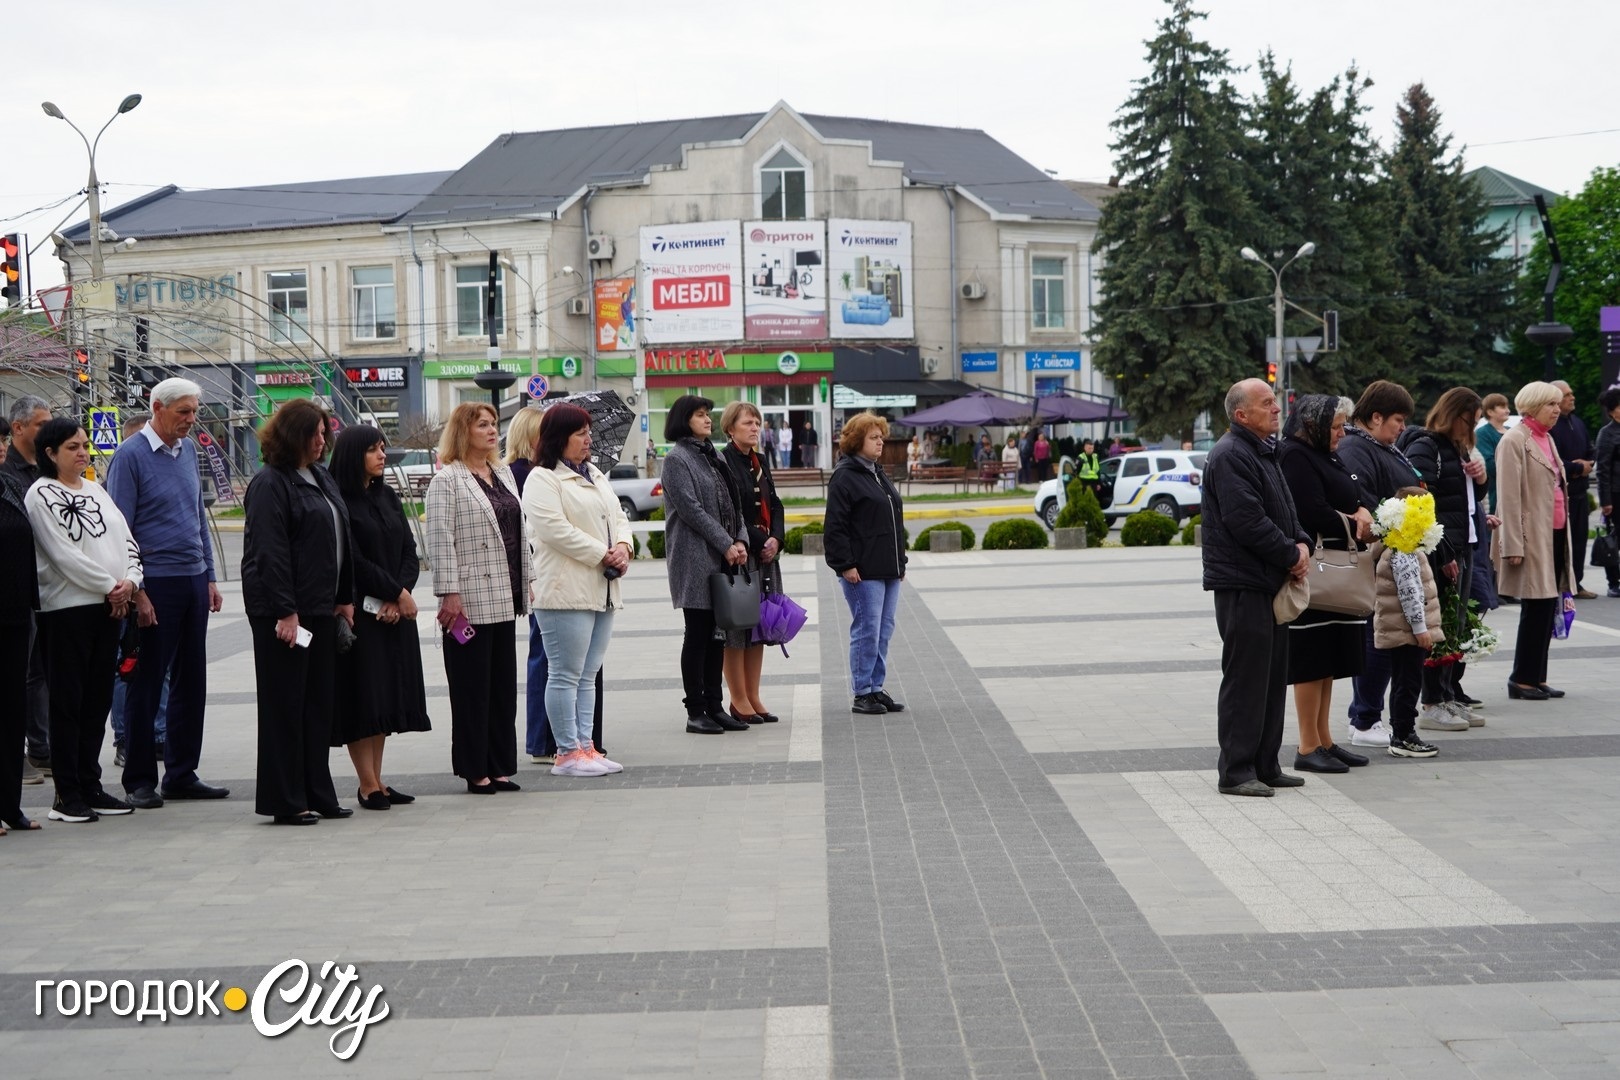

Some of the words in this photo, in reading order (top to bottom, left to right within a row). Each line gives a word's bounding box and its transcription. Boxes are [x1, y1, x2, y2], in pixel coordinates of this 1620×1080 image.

[668, 238, 726, 250] КОНТИНЕНТ
[854, 236, 898, 246] КОНТИНЕНТ
[677, 265, 687, 274] ТА
[688, 262, 731, 274] КОРПУСНІ
[115, 274, 237, 305] УРТІВНЯ
[660, 281, 724, 305] МЕБЛІ
[644, 349, 728, 371] АПТЕКА
[440, 363, 481, 376] ЗДОРОВА
[266, 373, 312, 385] АПТЕКА
